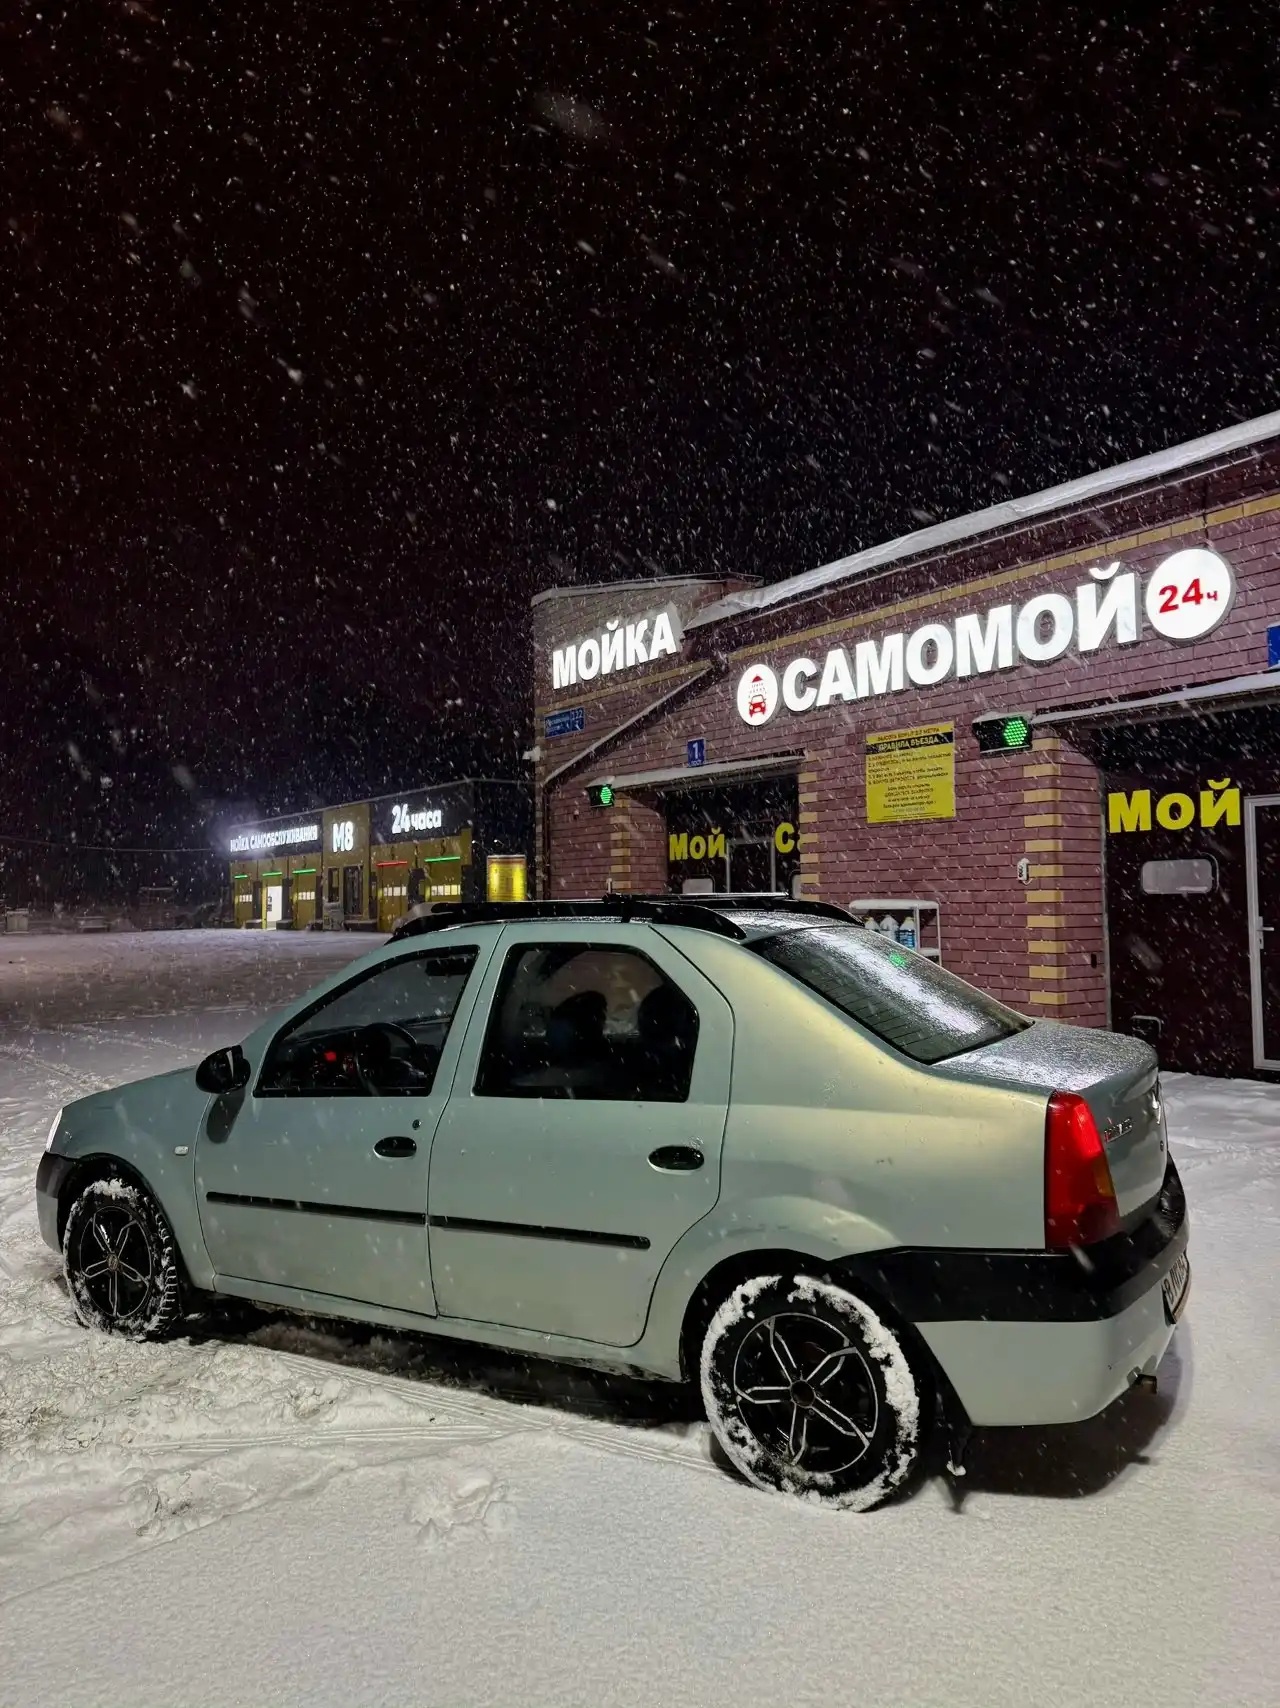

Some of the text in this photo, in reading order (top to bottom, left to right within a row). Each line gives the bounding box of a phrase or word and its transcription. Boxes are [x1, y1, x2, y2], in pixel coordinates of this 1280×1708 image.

[552, 612, 677, 689] МОЙКА
[782, 561, 1137, 712] САМОМОЙ
[692, 741, 699, 760] 1
[878, 735, 940, 752] ПРАВИЛА ВЪЕЗДА
[391, 803, 442, 834] 24 часа
[1108, 778, 1241, 834] Мой
[332, 821, 354, 853] М8
[668, 822, 801, 861] Мой С
